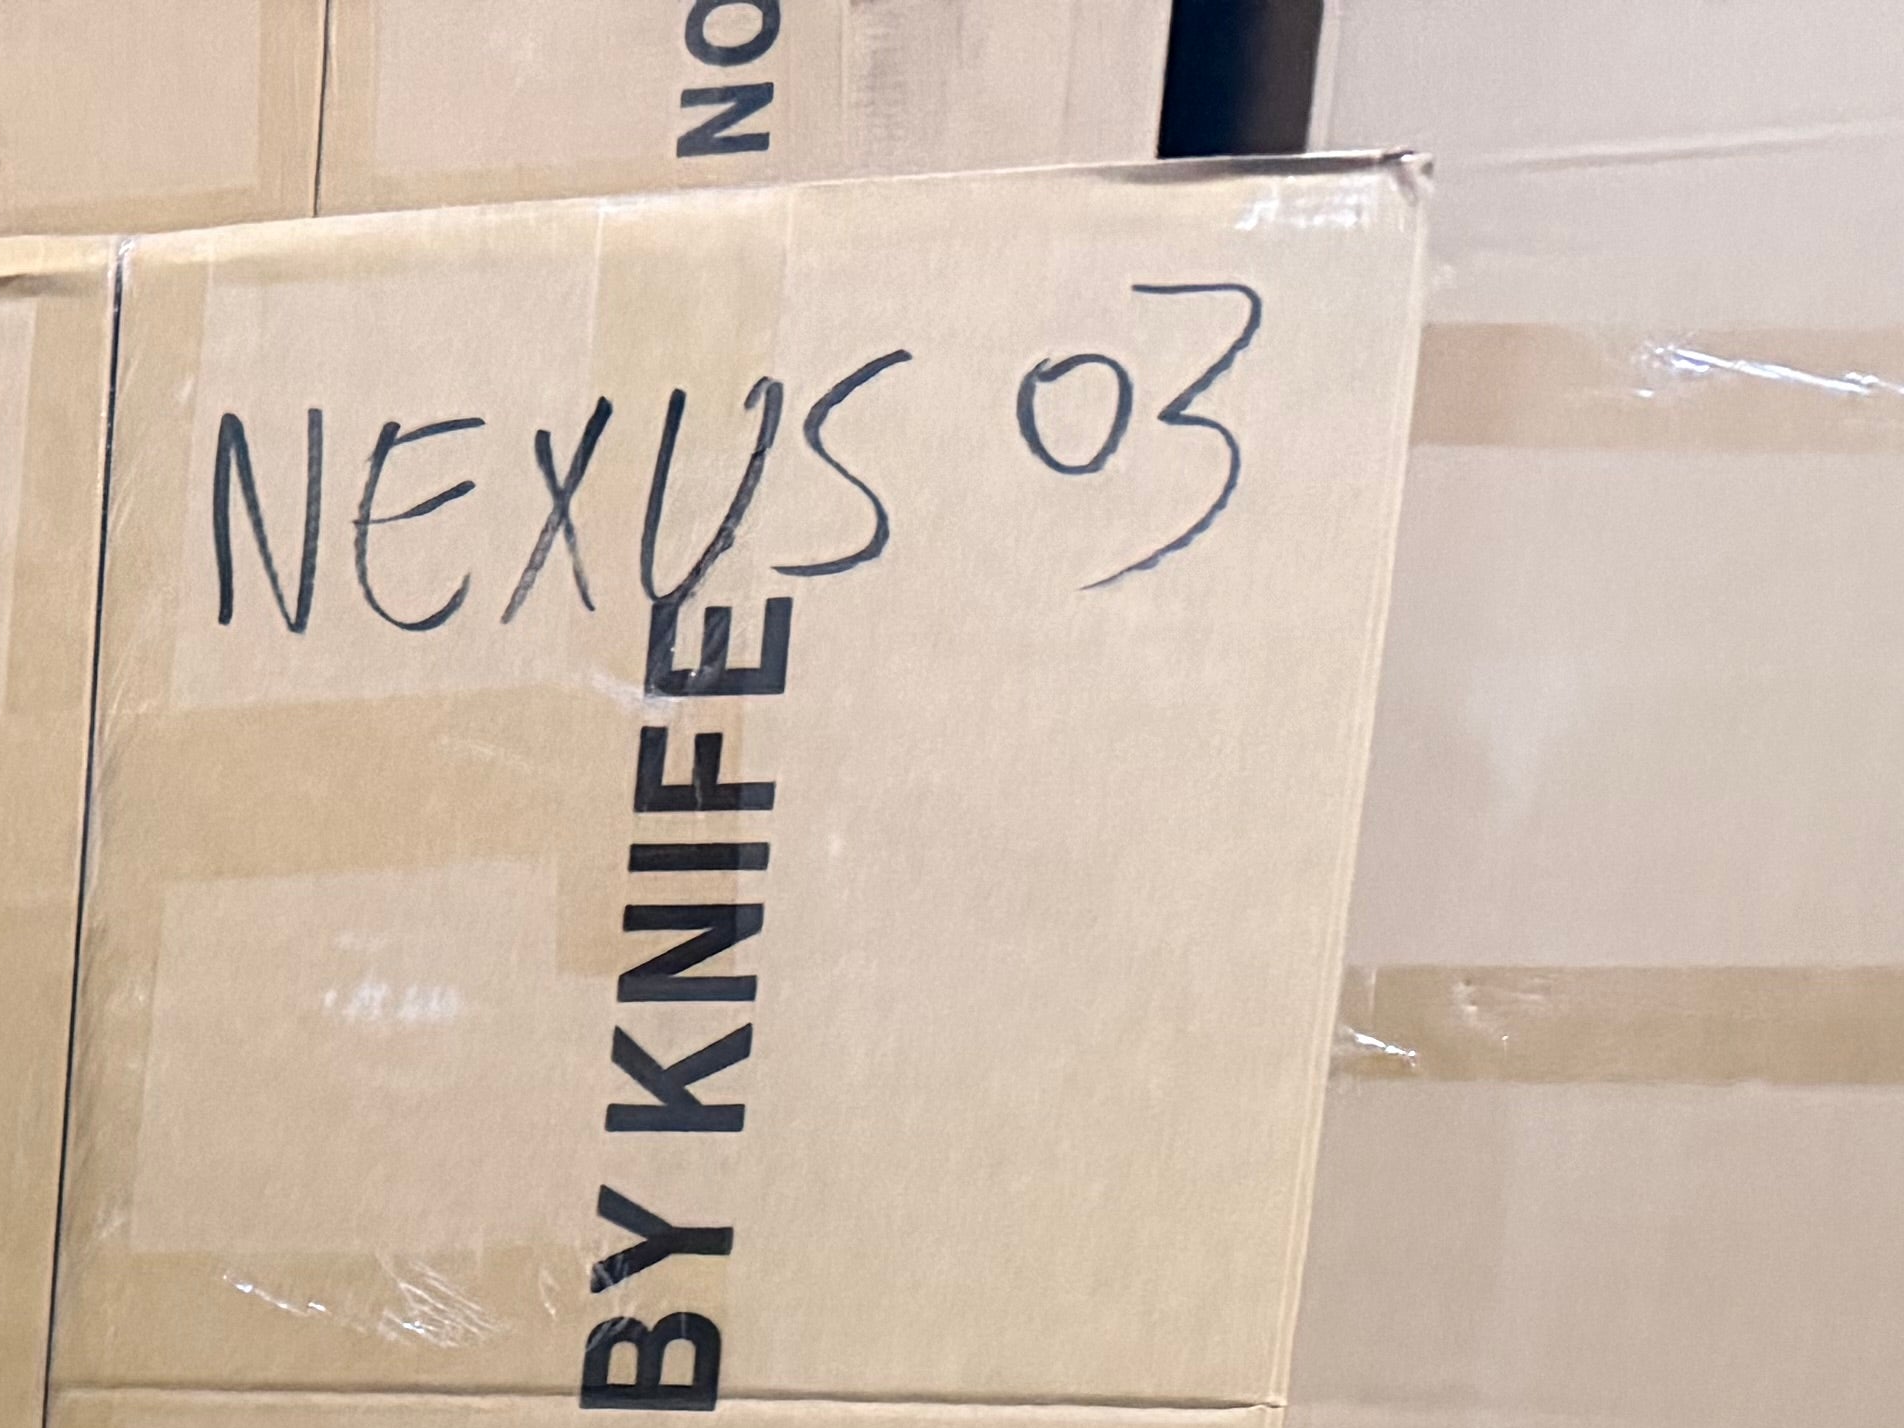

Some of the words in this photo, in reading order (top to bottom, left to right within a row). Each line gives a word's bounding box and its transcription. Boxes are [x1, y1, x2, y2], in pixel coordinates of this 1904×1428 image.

[676, 0, 781, 158] NO
[211, 348, 912, 635] NEXUS
[1016, 283, 1262, 591] 03
[605, 594, 793, 1133] KNIFE
[580, 1184, 735, 1412] BY
